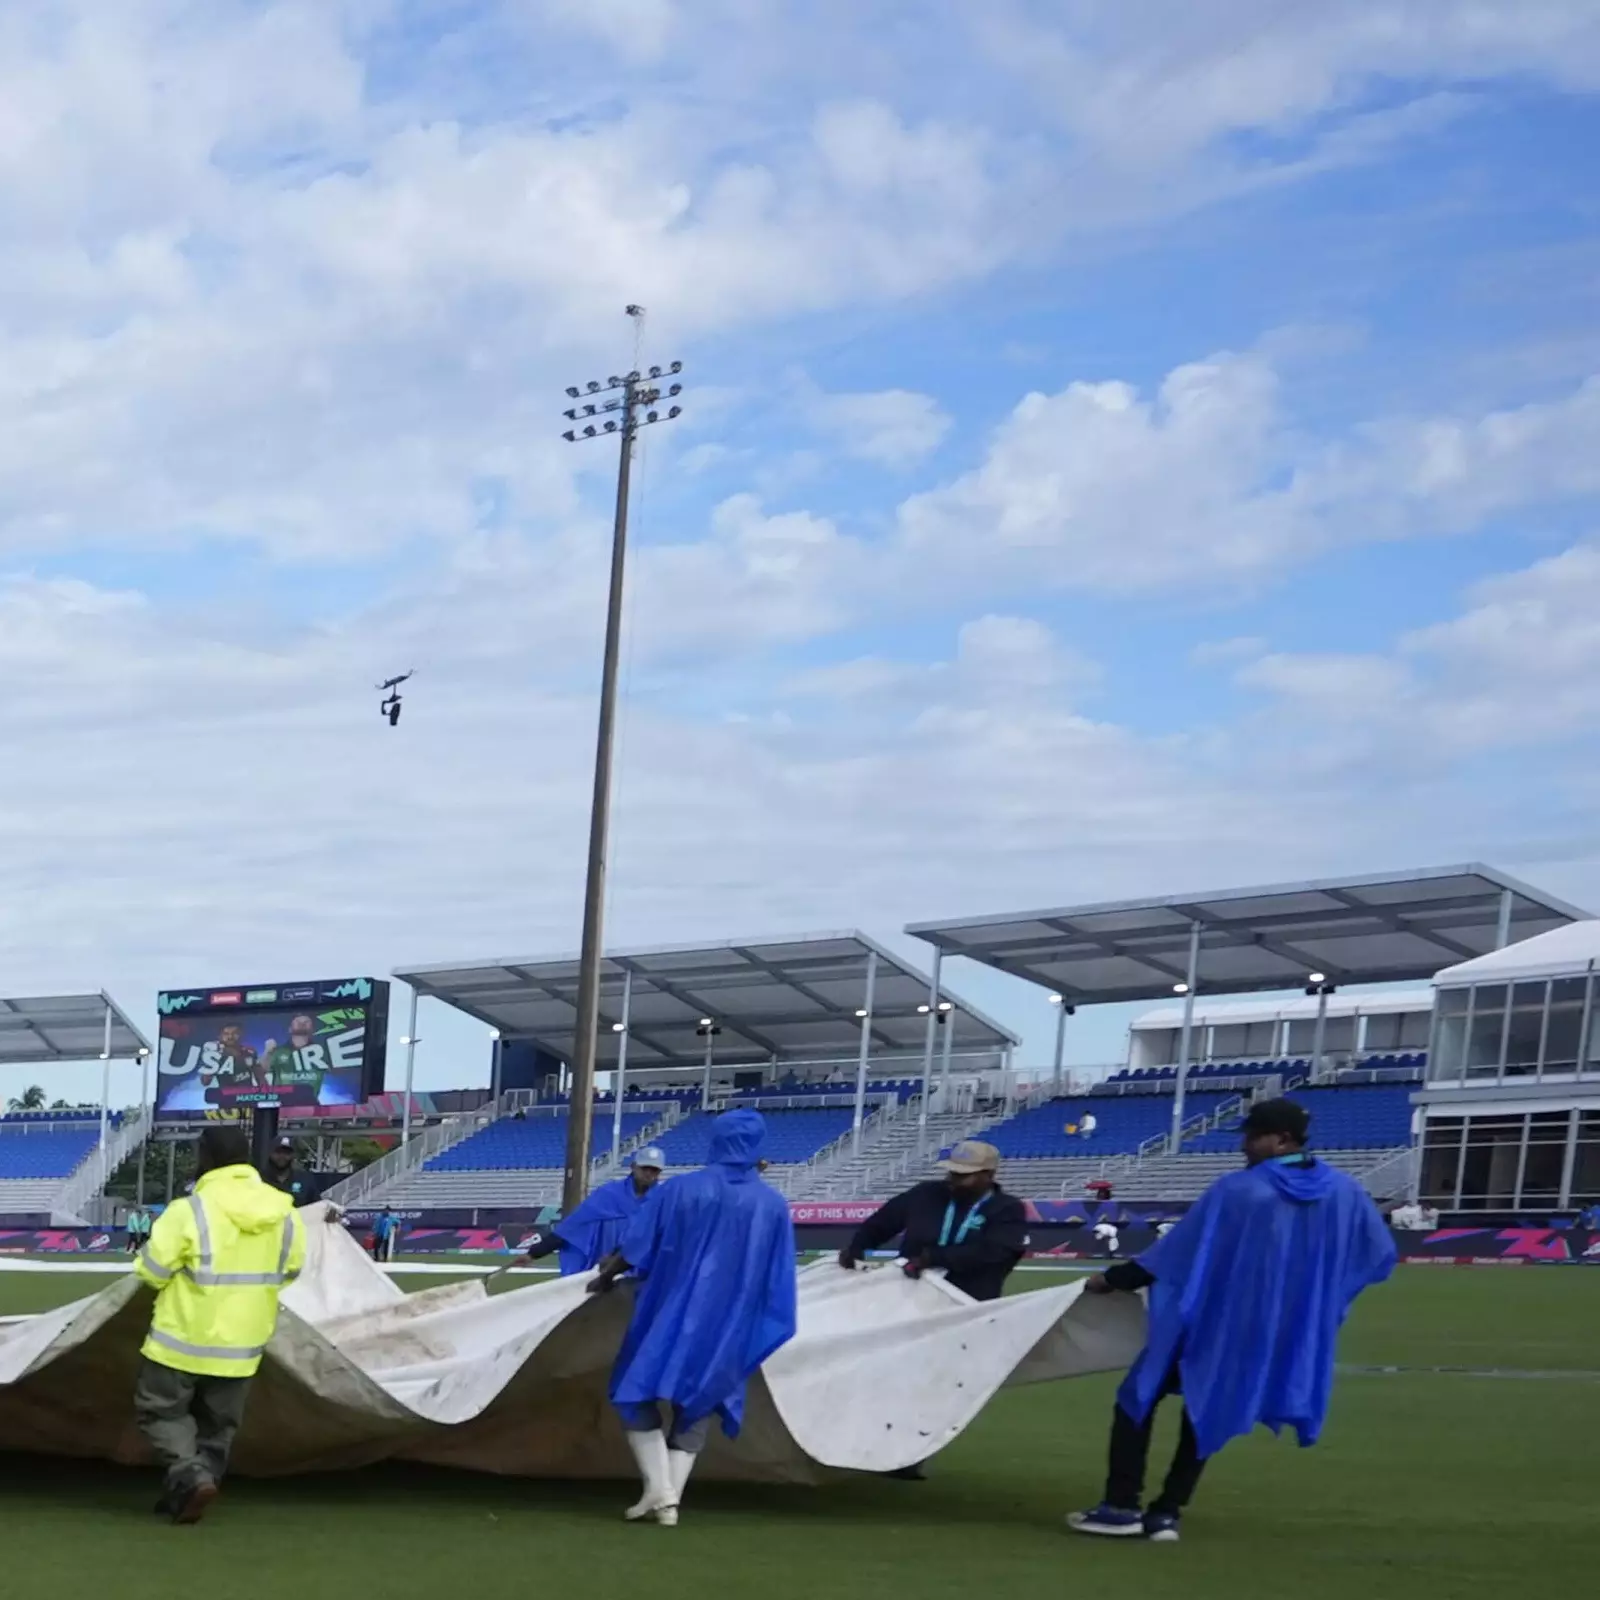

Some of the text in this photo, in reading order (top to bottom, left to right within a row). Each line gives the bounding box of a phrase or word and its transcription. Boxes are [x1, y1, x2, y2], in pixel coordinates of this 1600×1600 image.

[158, 1036, 235, 1076] USA
[293, 1026, 366, 1072] IRE
[236, 1093, 265, 1102] MATCH
[798, 1207, 816, 1218] OF
[818, 1207, 843, 1219] THIS
[844, 1207, 879, 1218] WOR
